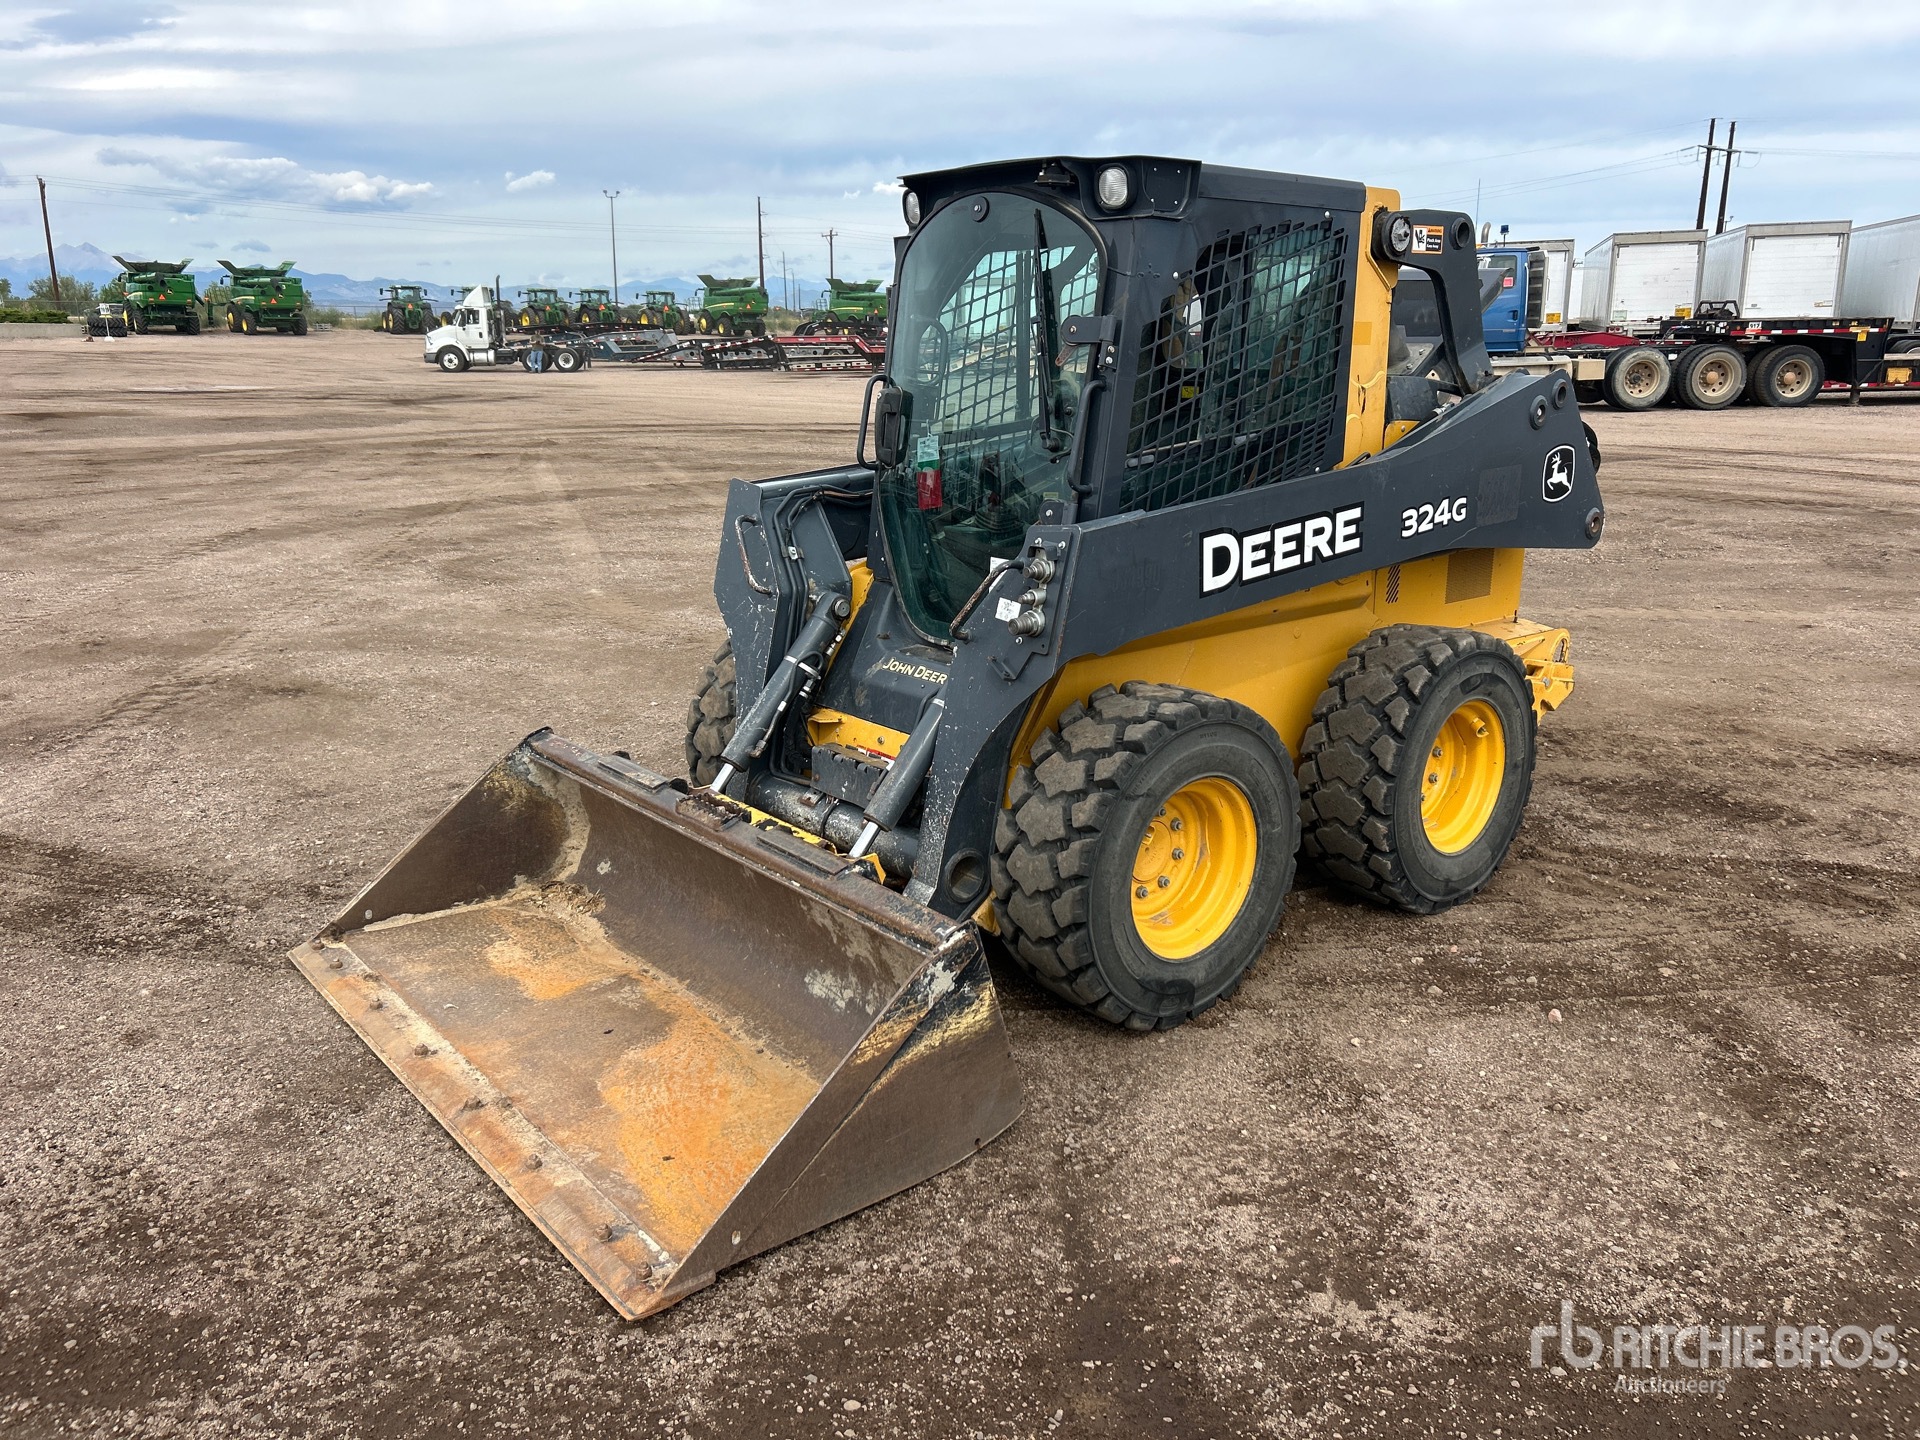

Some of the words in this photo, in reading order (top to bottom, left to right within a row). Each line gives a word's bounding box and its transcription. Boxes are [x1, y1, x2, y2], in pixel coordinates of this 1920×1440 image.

[1401, 497, 1467, 538] 324G
[1202, 506, 1362, 594] DEERE
[882, 658, 916, 676] JOHN
[914, 665, 948, 685] DEER
